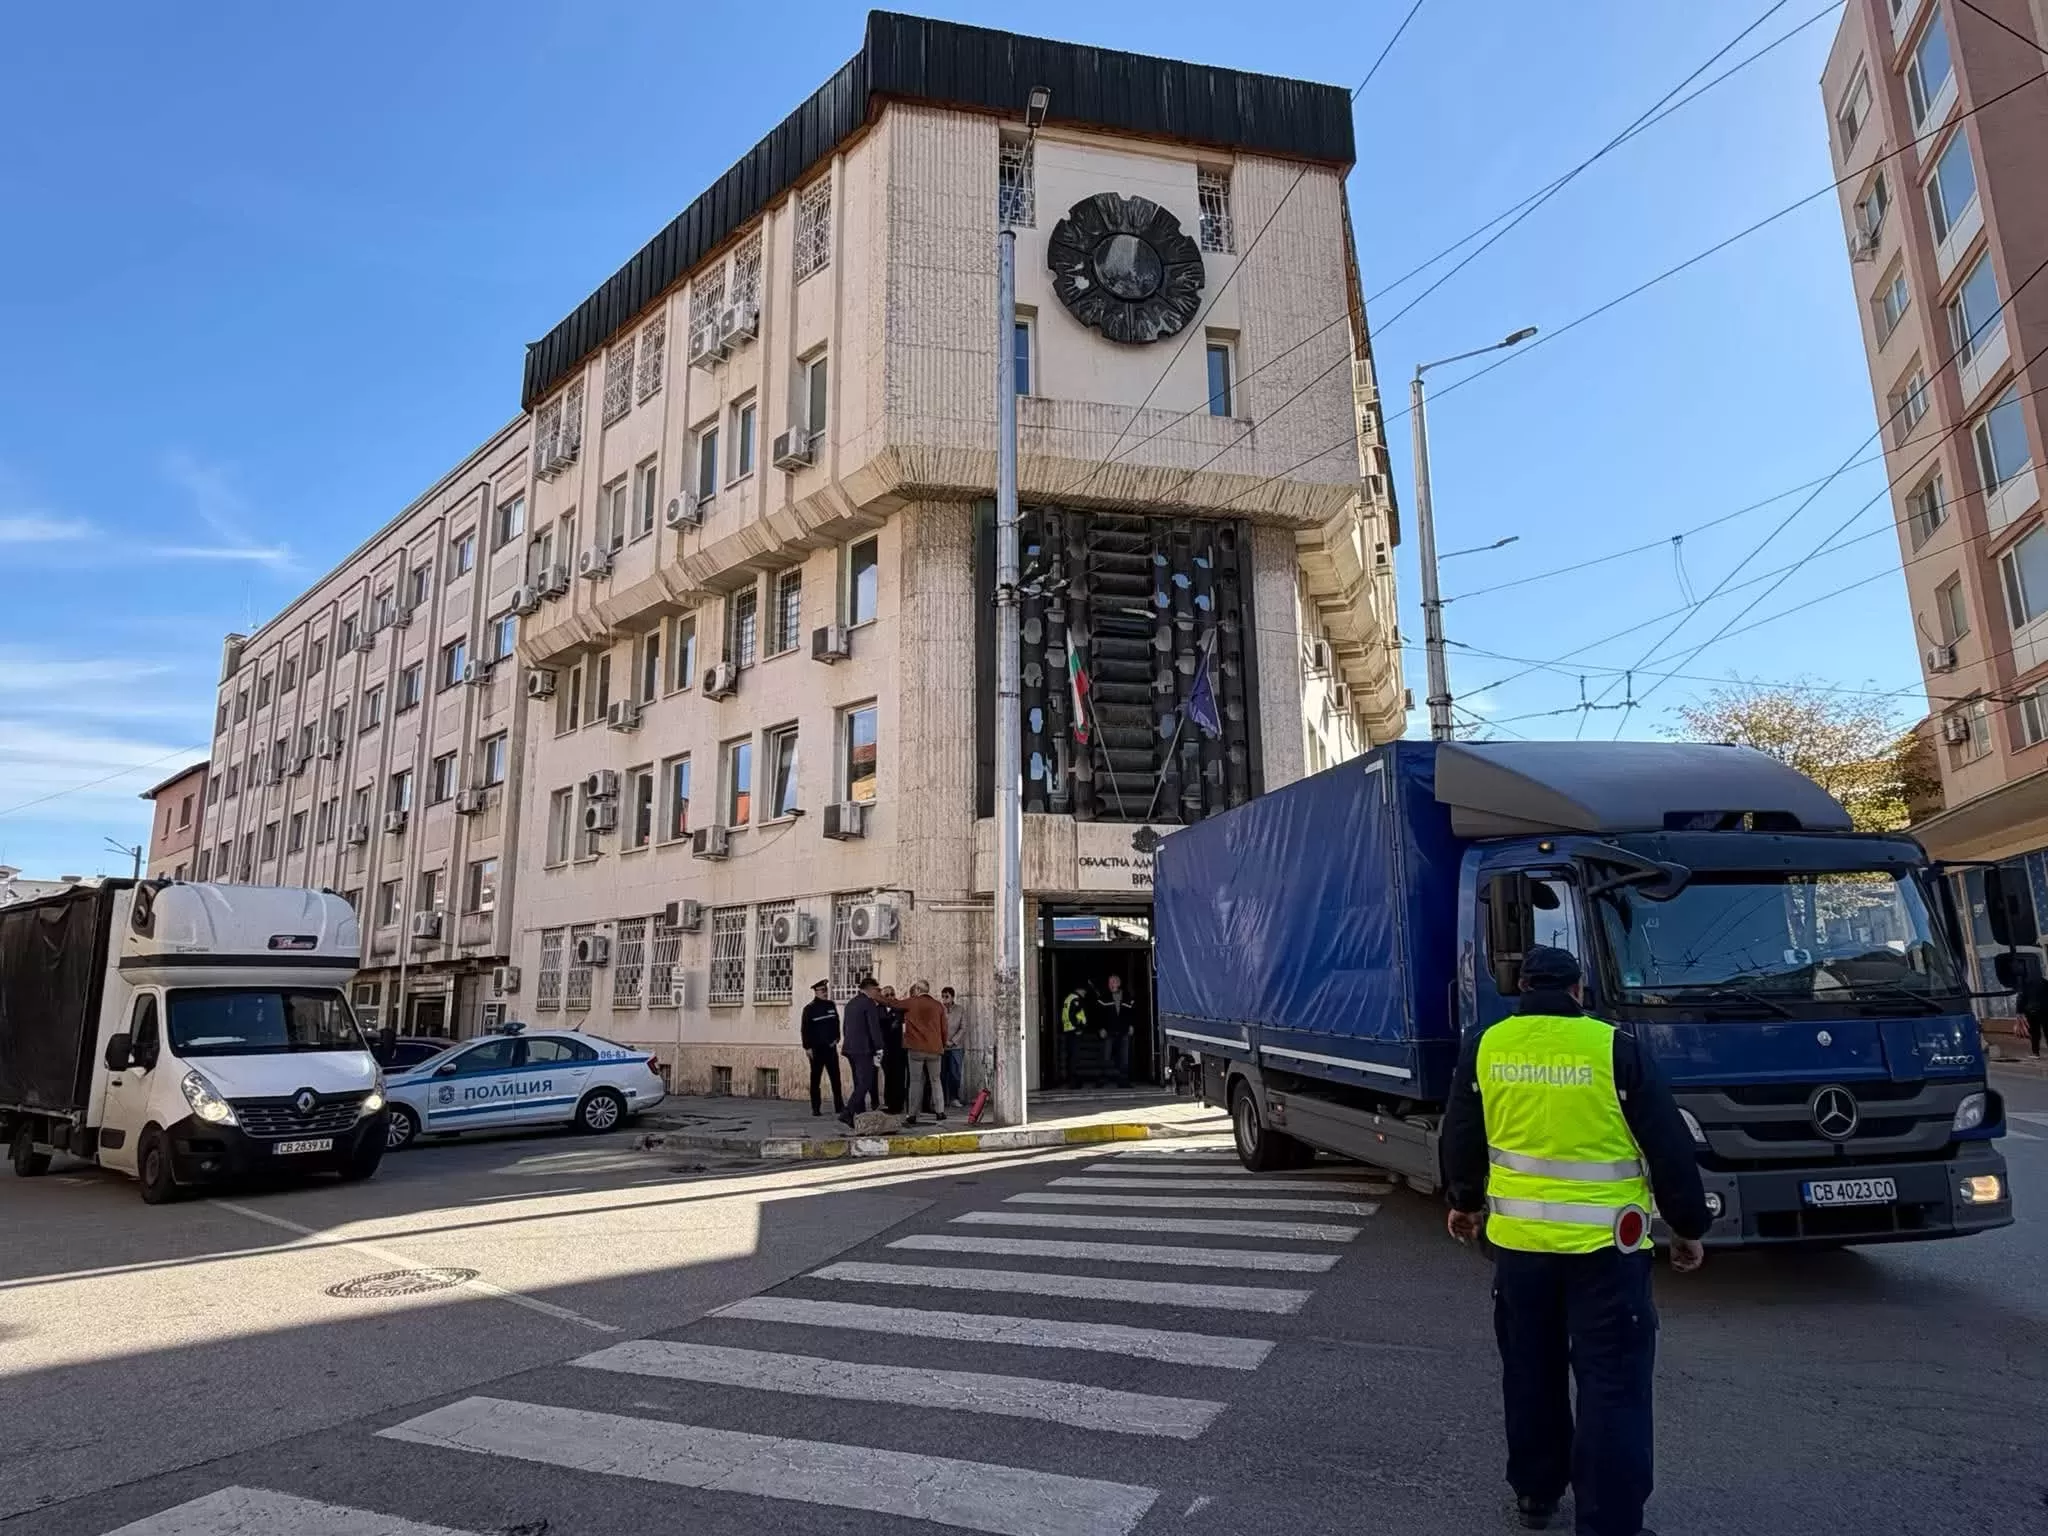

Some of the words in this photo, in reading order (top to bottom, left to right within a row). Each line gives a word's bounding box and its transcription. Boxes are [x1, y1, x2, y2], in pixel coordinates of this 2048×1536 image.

[1079, 857, 1130, 868] ОБЛАСТНА
[1132, 858, 1154, 869] АДМ
[1132, 873, 1154, 885] ВРА
[1490, 1063, 1594, 1088] ПОЛИЦИЯ
[464, 1079, 553, 1101] ПОЛИЦИЯ
[1837, 1182, 1872, 1199] 4023
